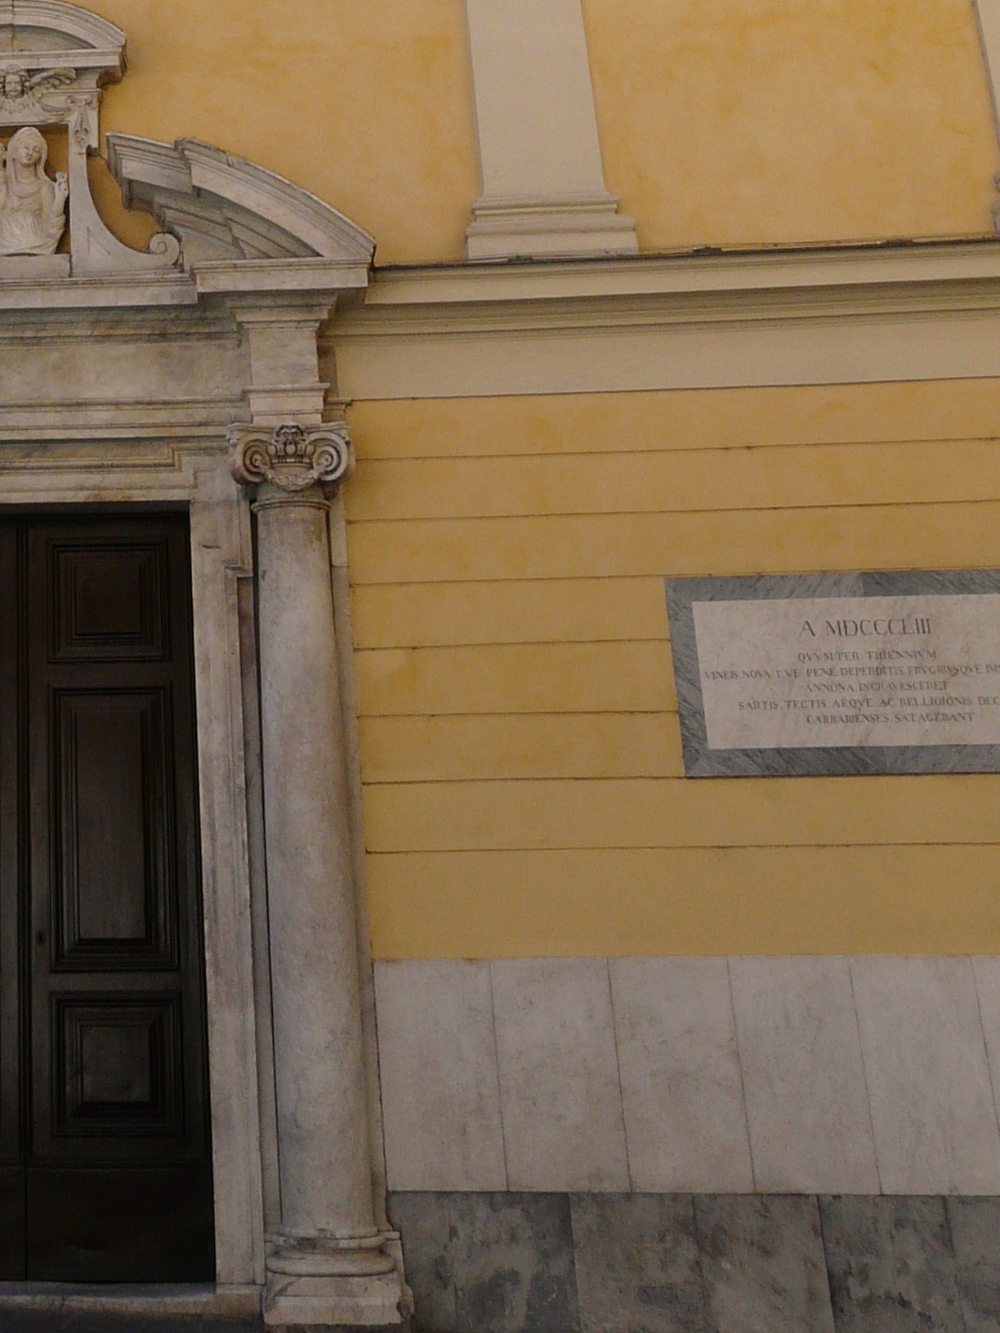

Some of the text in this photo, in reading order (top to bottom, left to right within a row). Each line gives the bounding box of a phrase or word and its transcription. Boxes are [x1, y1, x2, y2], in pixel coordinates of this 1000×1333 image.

[799, 618, 932, 637] A MDCCCLIII
[783, 699, 827, 710] TECTIS
[880, 697, 896, 707] AC
